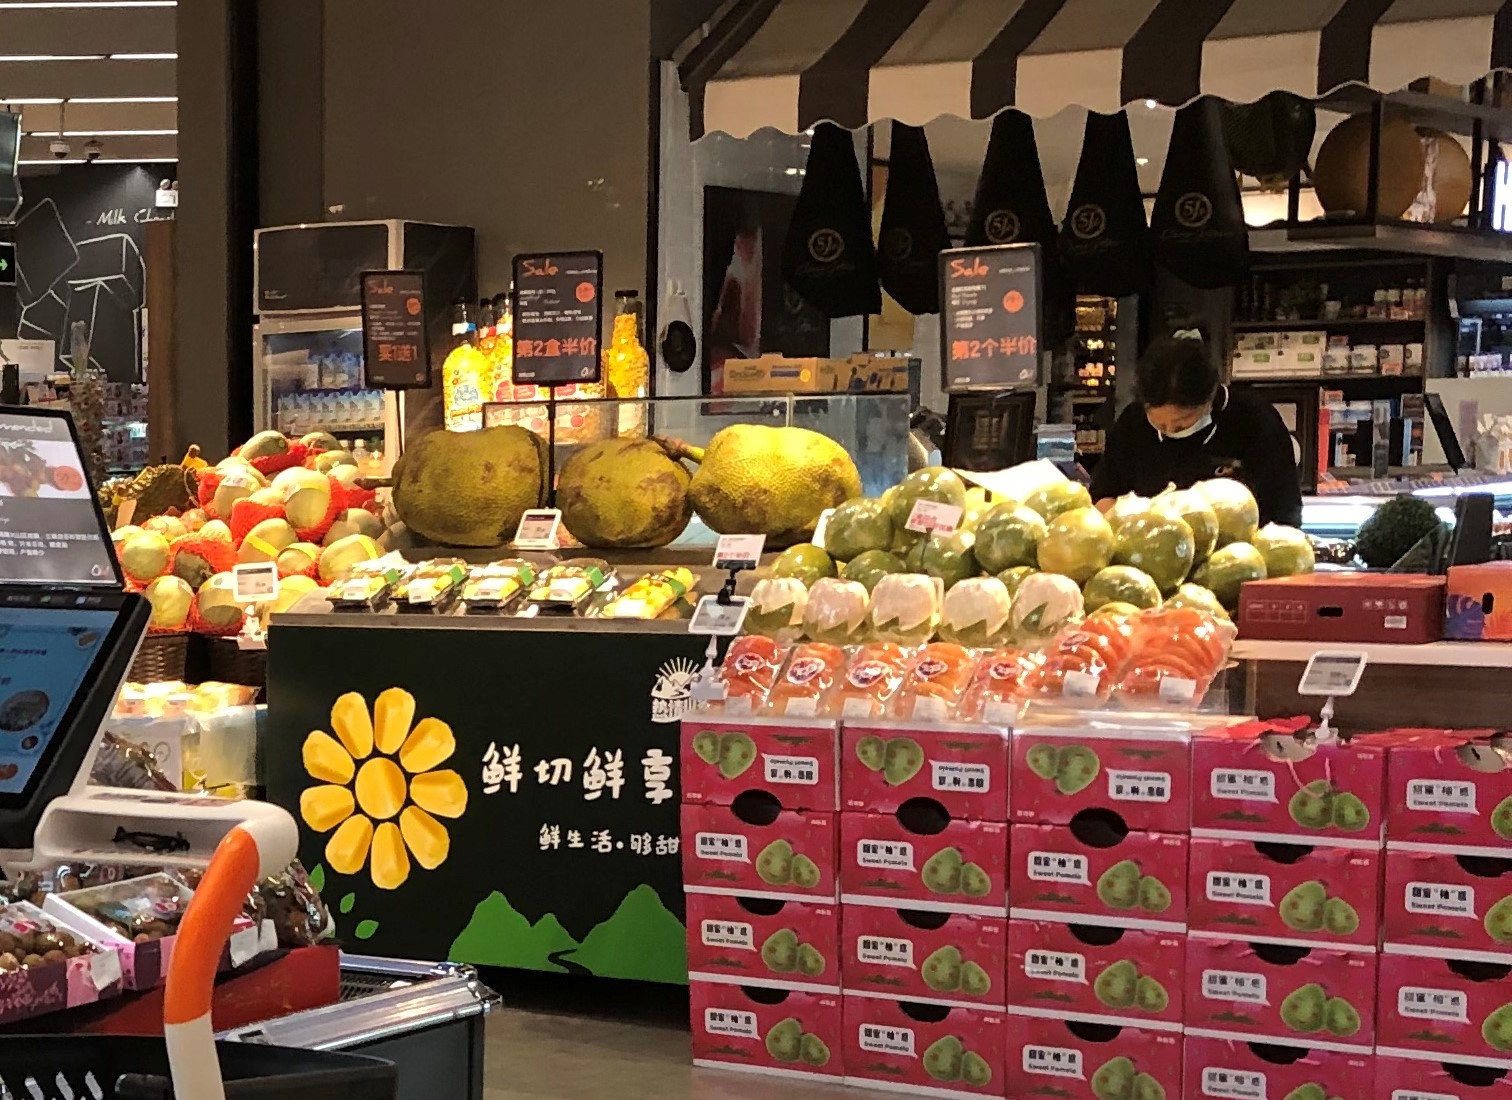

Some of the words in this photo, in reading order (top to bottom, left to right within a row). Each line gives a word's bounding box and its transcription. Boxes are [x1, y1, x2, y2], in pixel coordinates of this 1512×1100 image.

[522, 258, 559, 277] Sale
[950, 257, 989, 278] Sale
[952, 335, 1037, 360] 第2个半价
[482, 741, 673, 805] 鲜切鲜享
